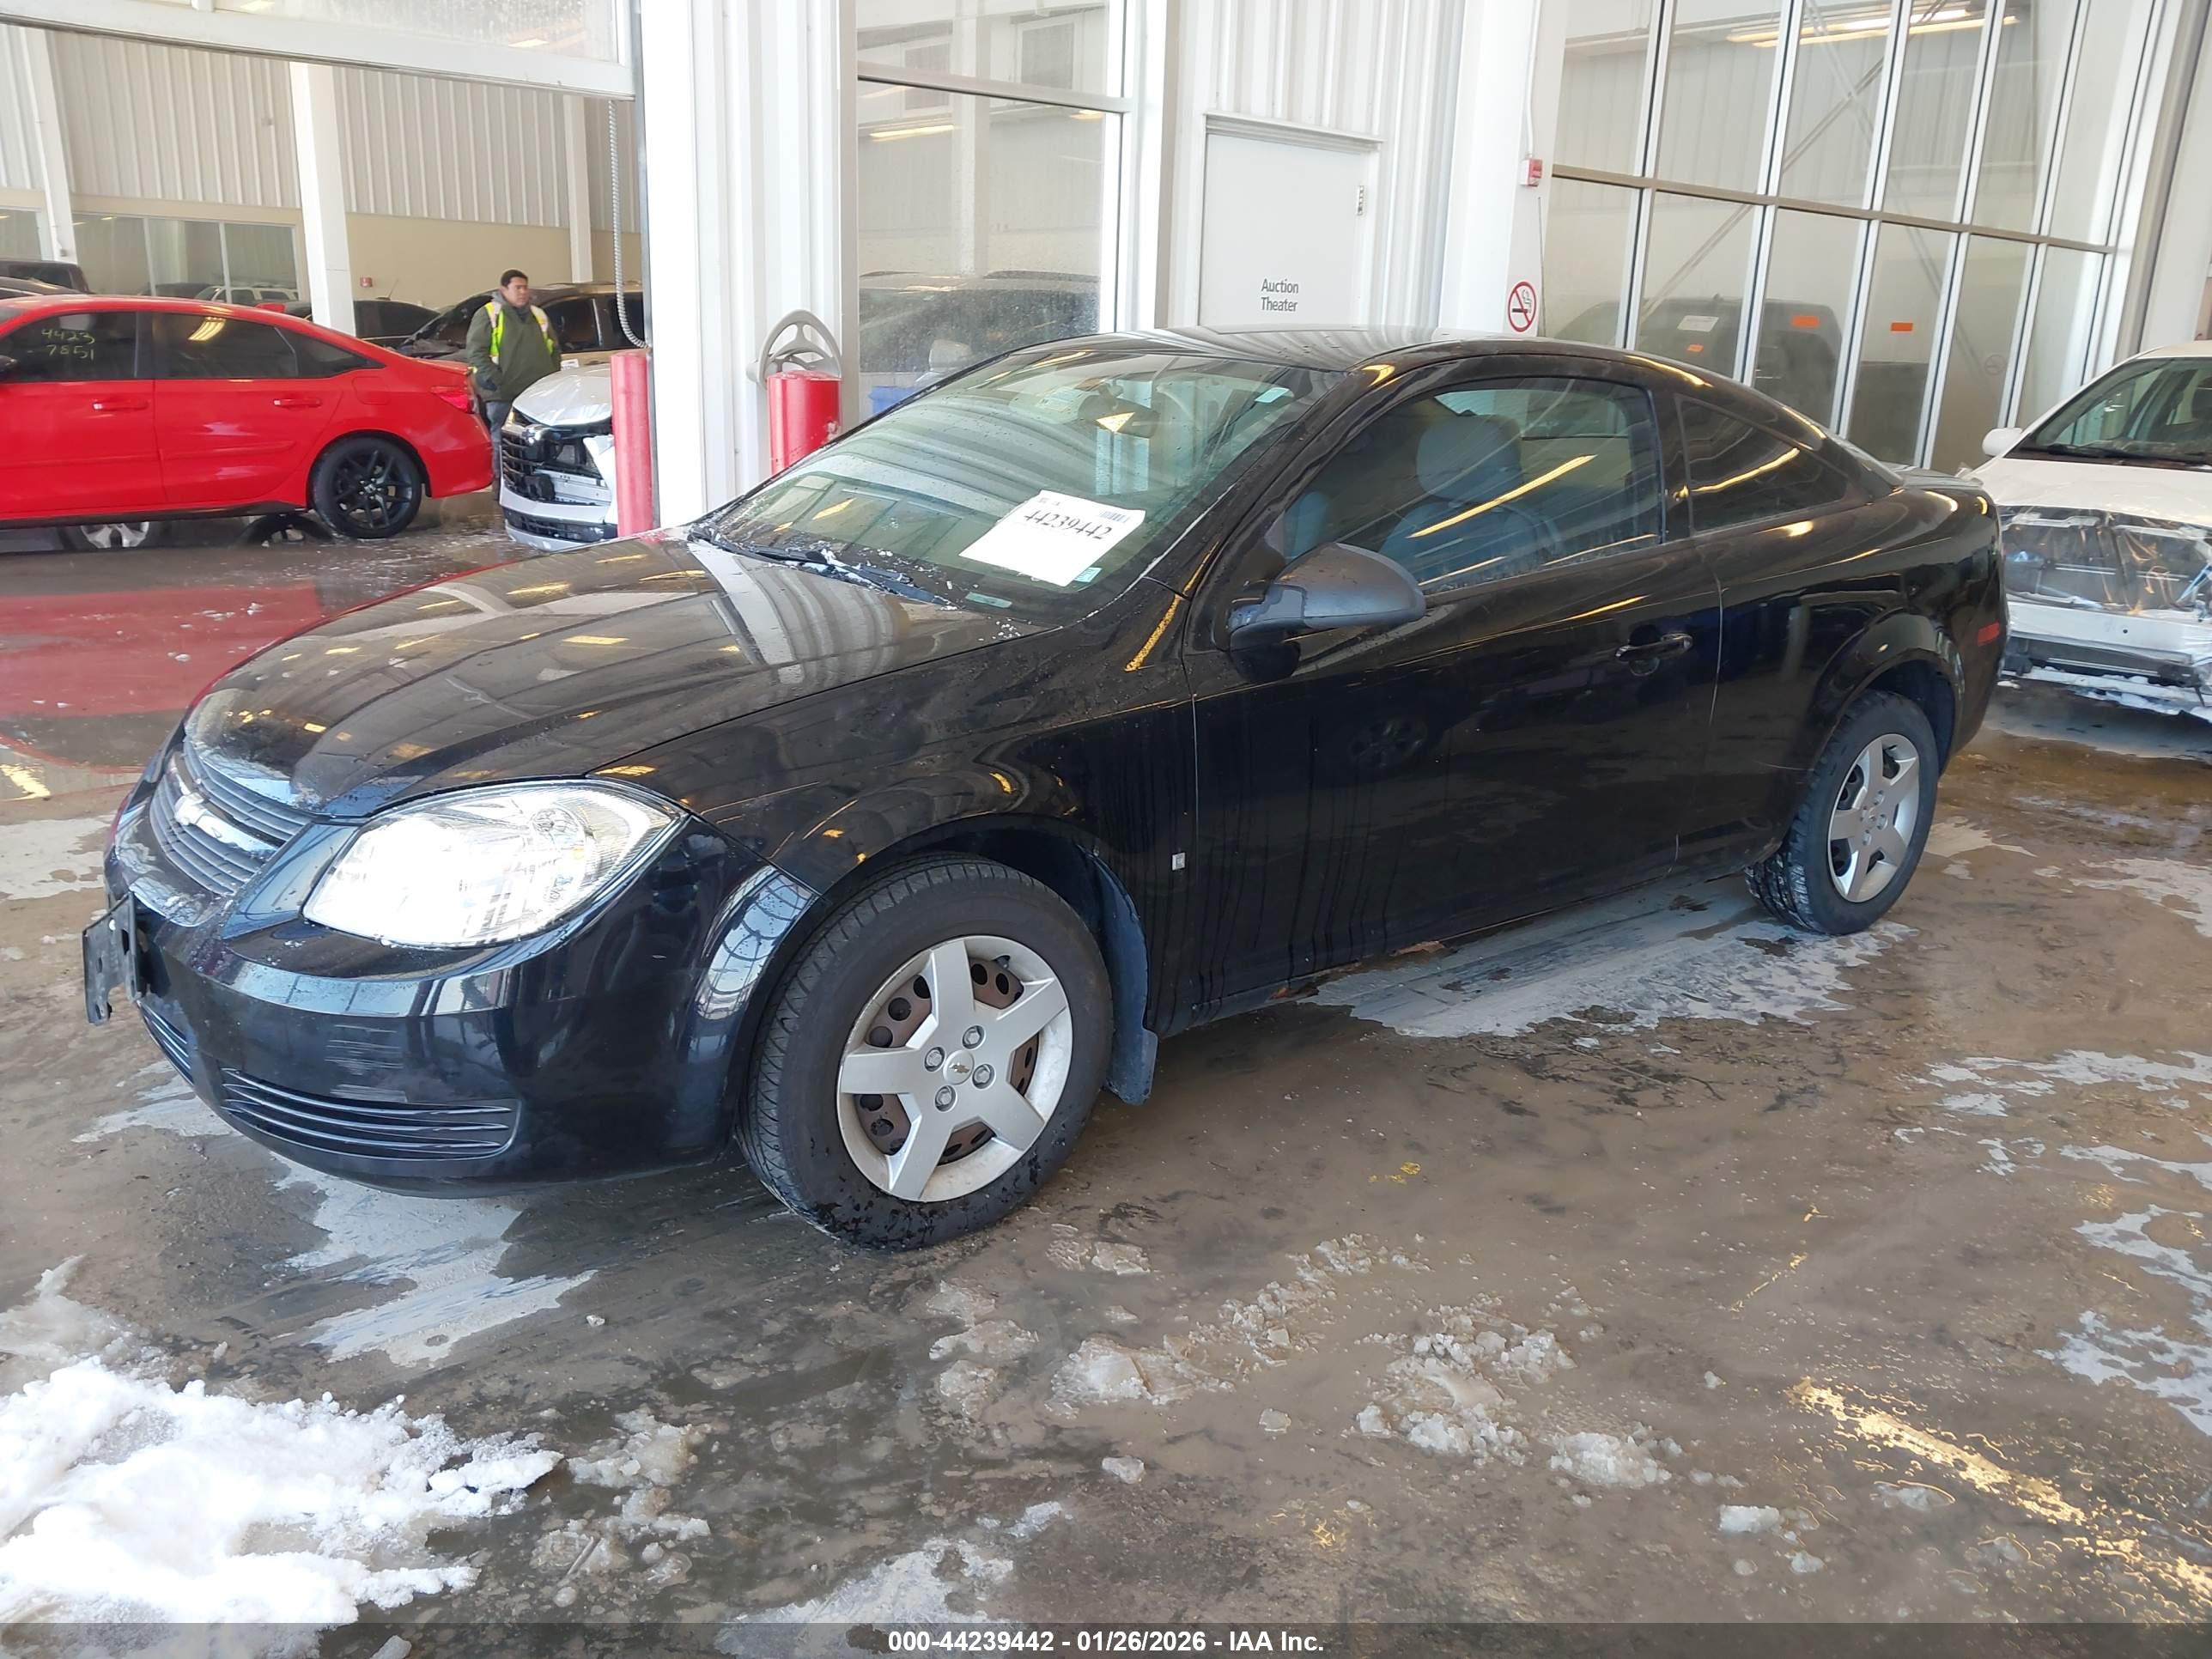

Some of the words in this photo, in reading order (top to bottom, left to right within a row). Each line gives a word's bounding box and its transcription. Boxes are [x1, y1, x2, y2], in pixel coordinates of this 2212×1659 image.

[1261, 278, 1298, 293] Auction
[1261, 296, 1297, 311] Theater
[46, 344, 94, 360] 7851
[1024, 510, 1112, 539] 44239442
